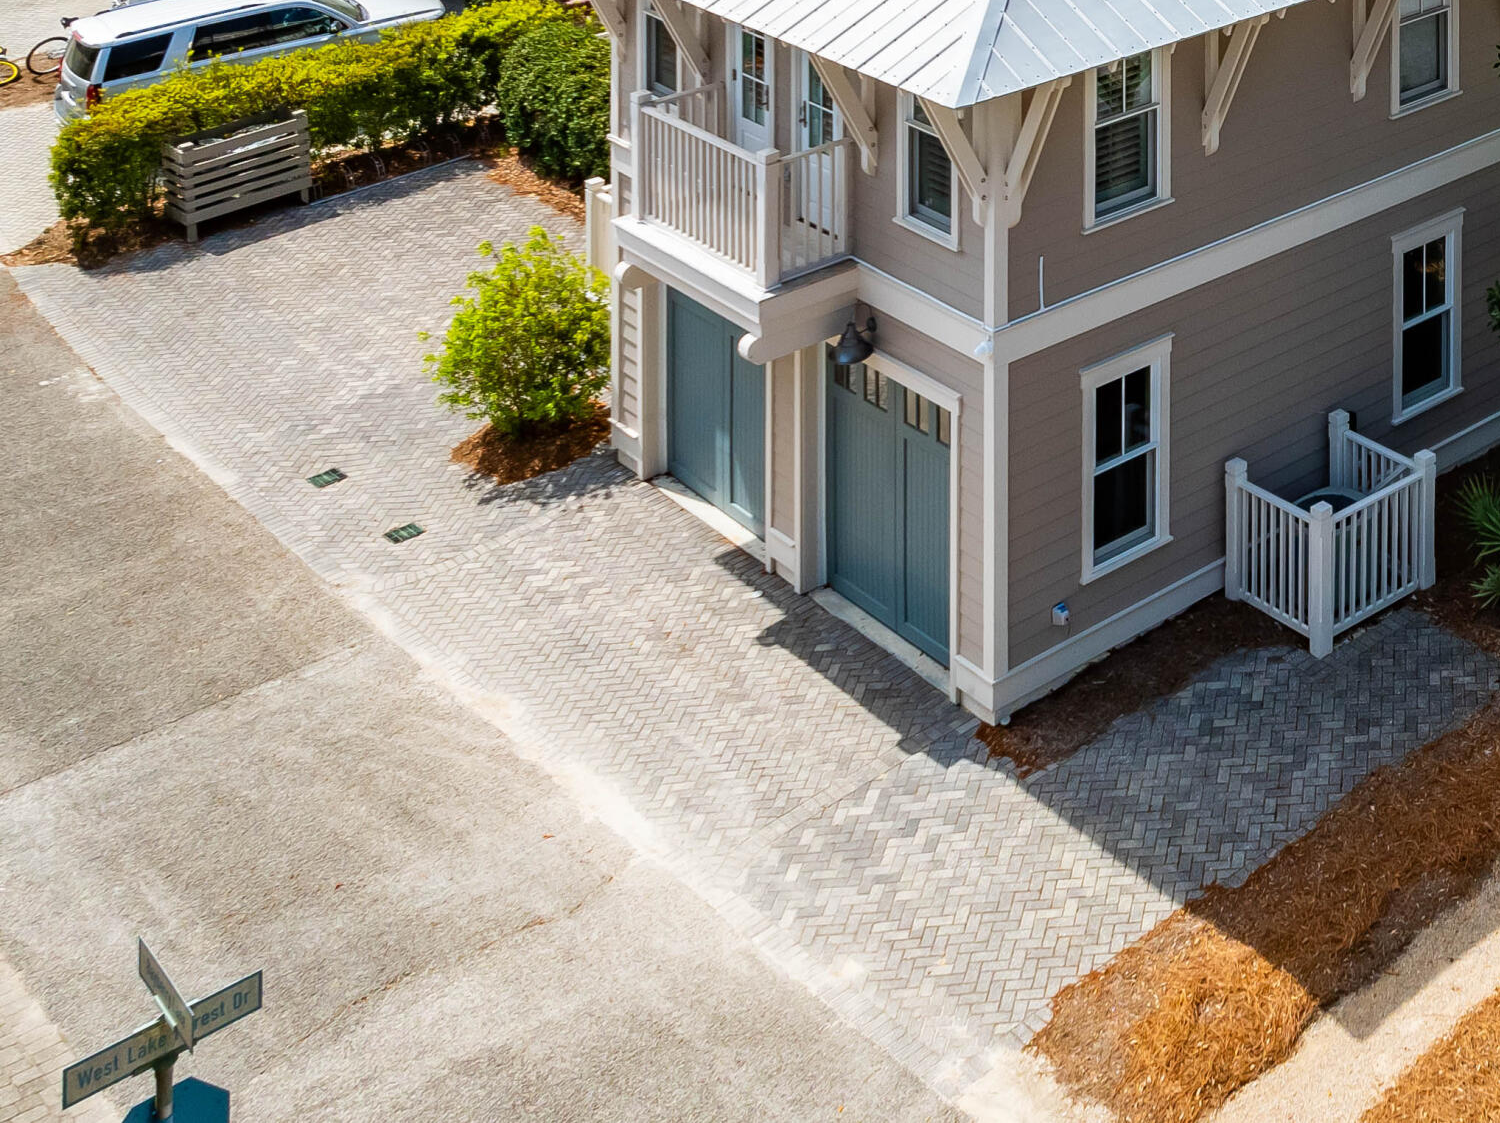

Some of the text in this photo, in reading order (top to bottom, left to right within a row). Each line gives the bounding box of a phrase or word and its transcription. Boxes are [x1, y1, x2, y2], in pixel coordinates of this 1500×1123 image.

[78, 1056, 119, 1088] West
[128, 1034, 166, 1064] Lake
[233, 990, 250, 1009] Dr
